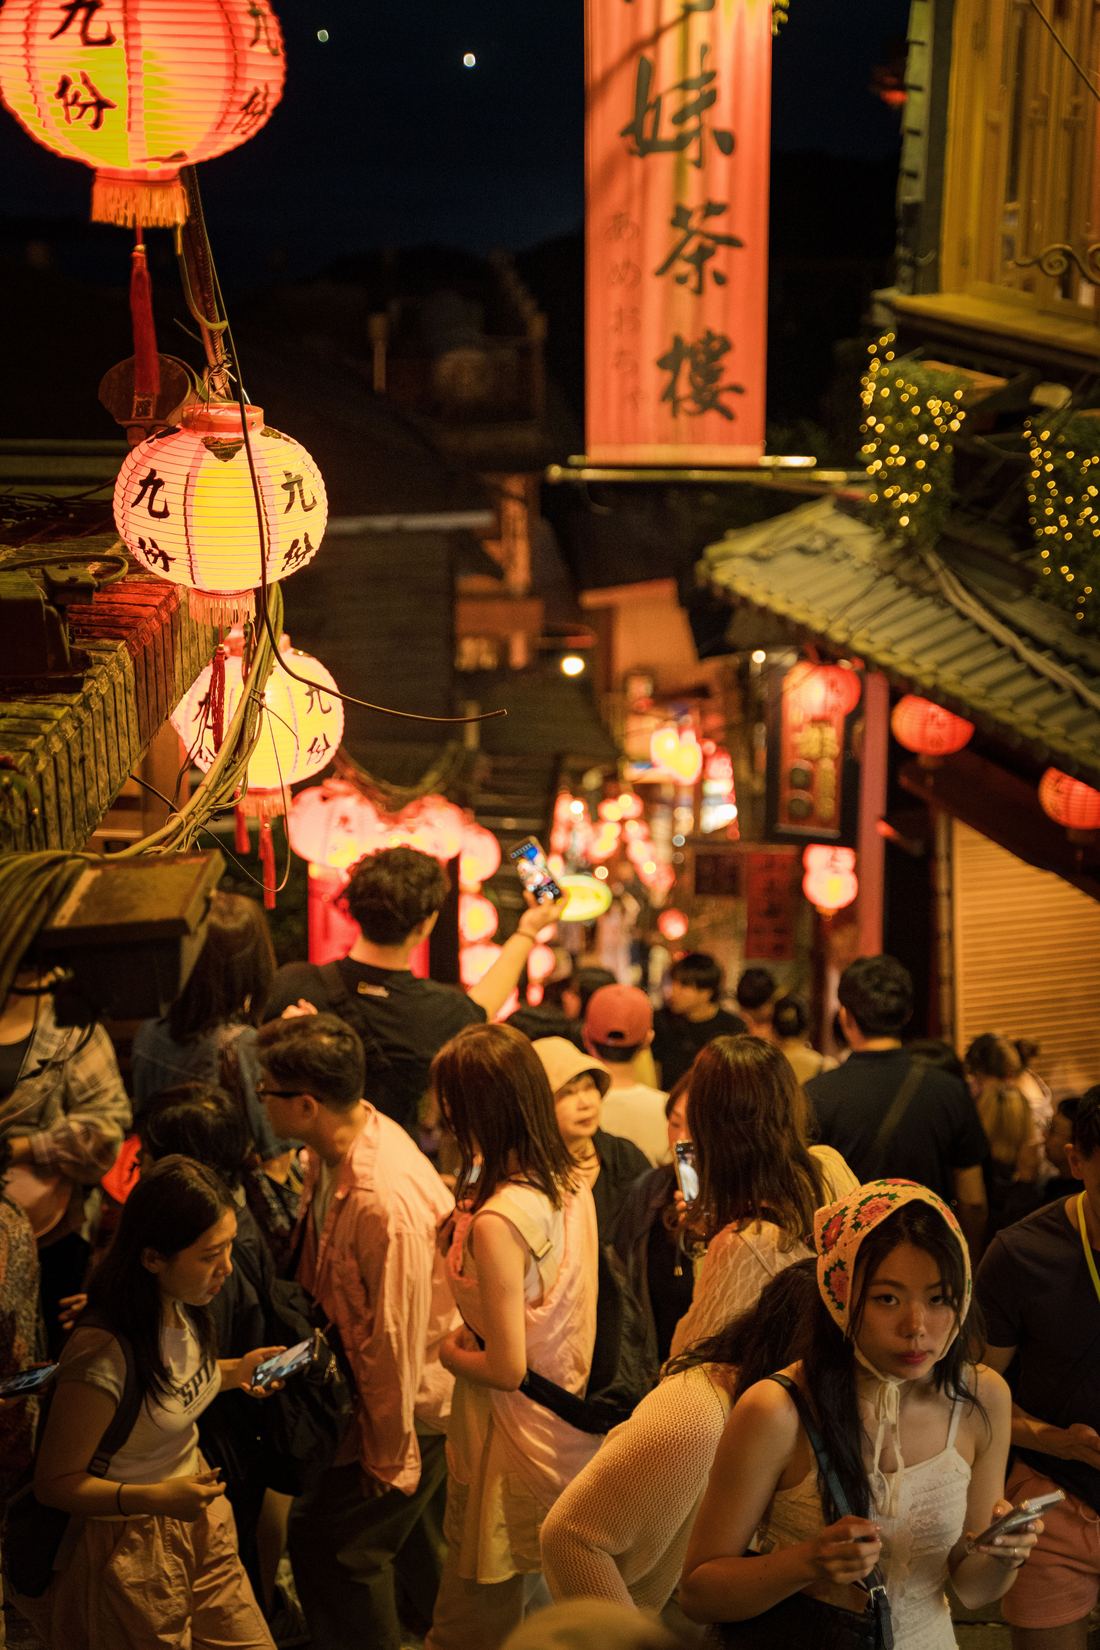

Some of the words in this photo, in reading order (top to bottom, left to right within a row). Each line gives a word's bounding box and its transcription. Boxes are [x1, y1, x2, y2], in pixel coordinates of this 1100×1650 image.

[50, 0, 117, 130] 九份
[619, 0, 746, 421] 妹茶樓
[131, 468, 176, 573] 九份
[281, 470, 318, 572] 九份
